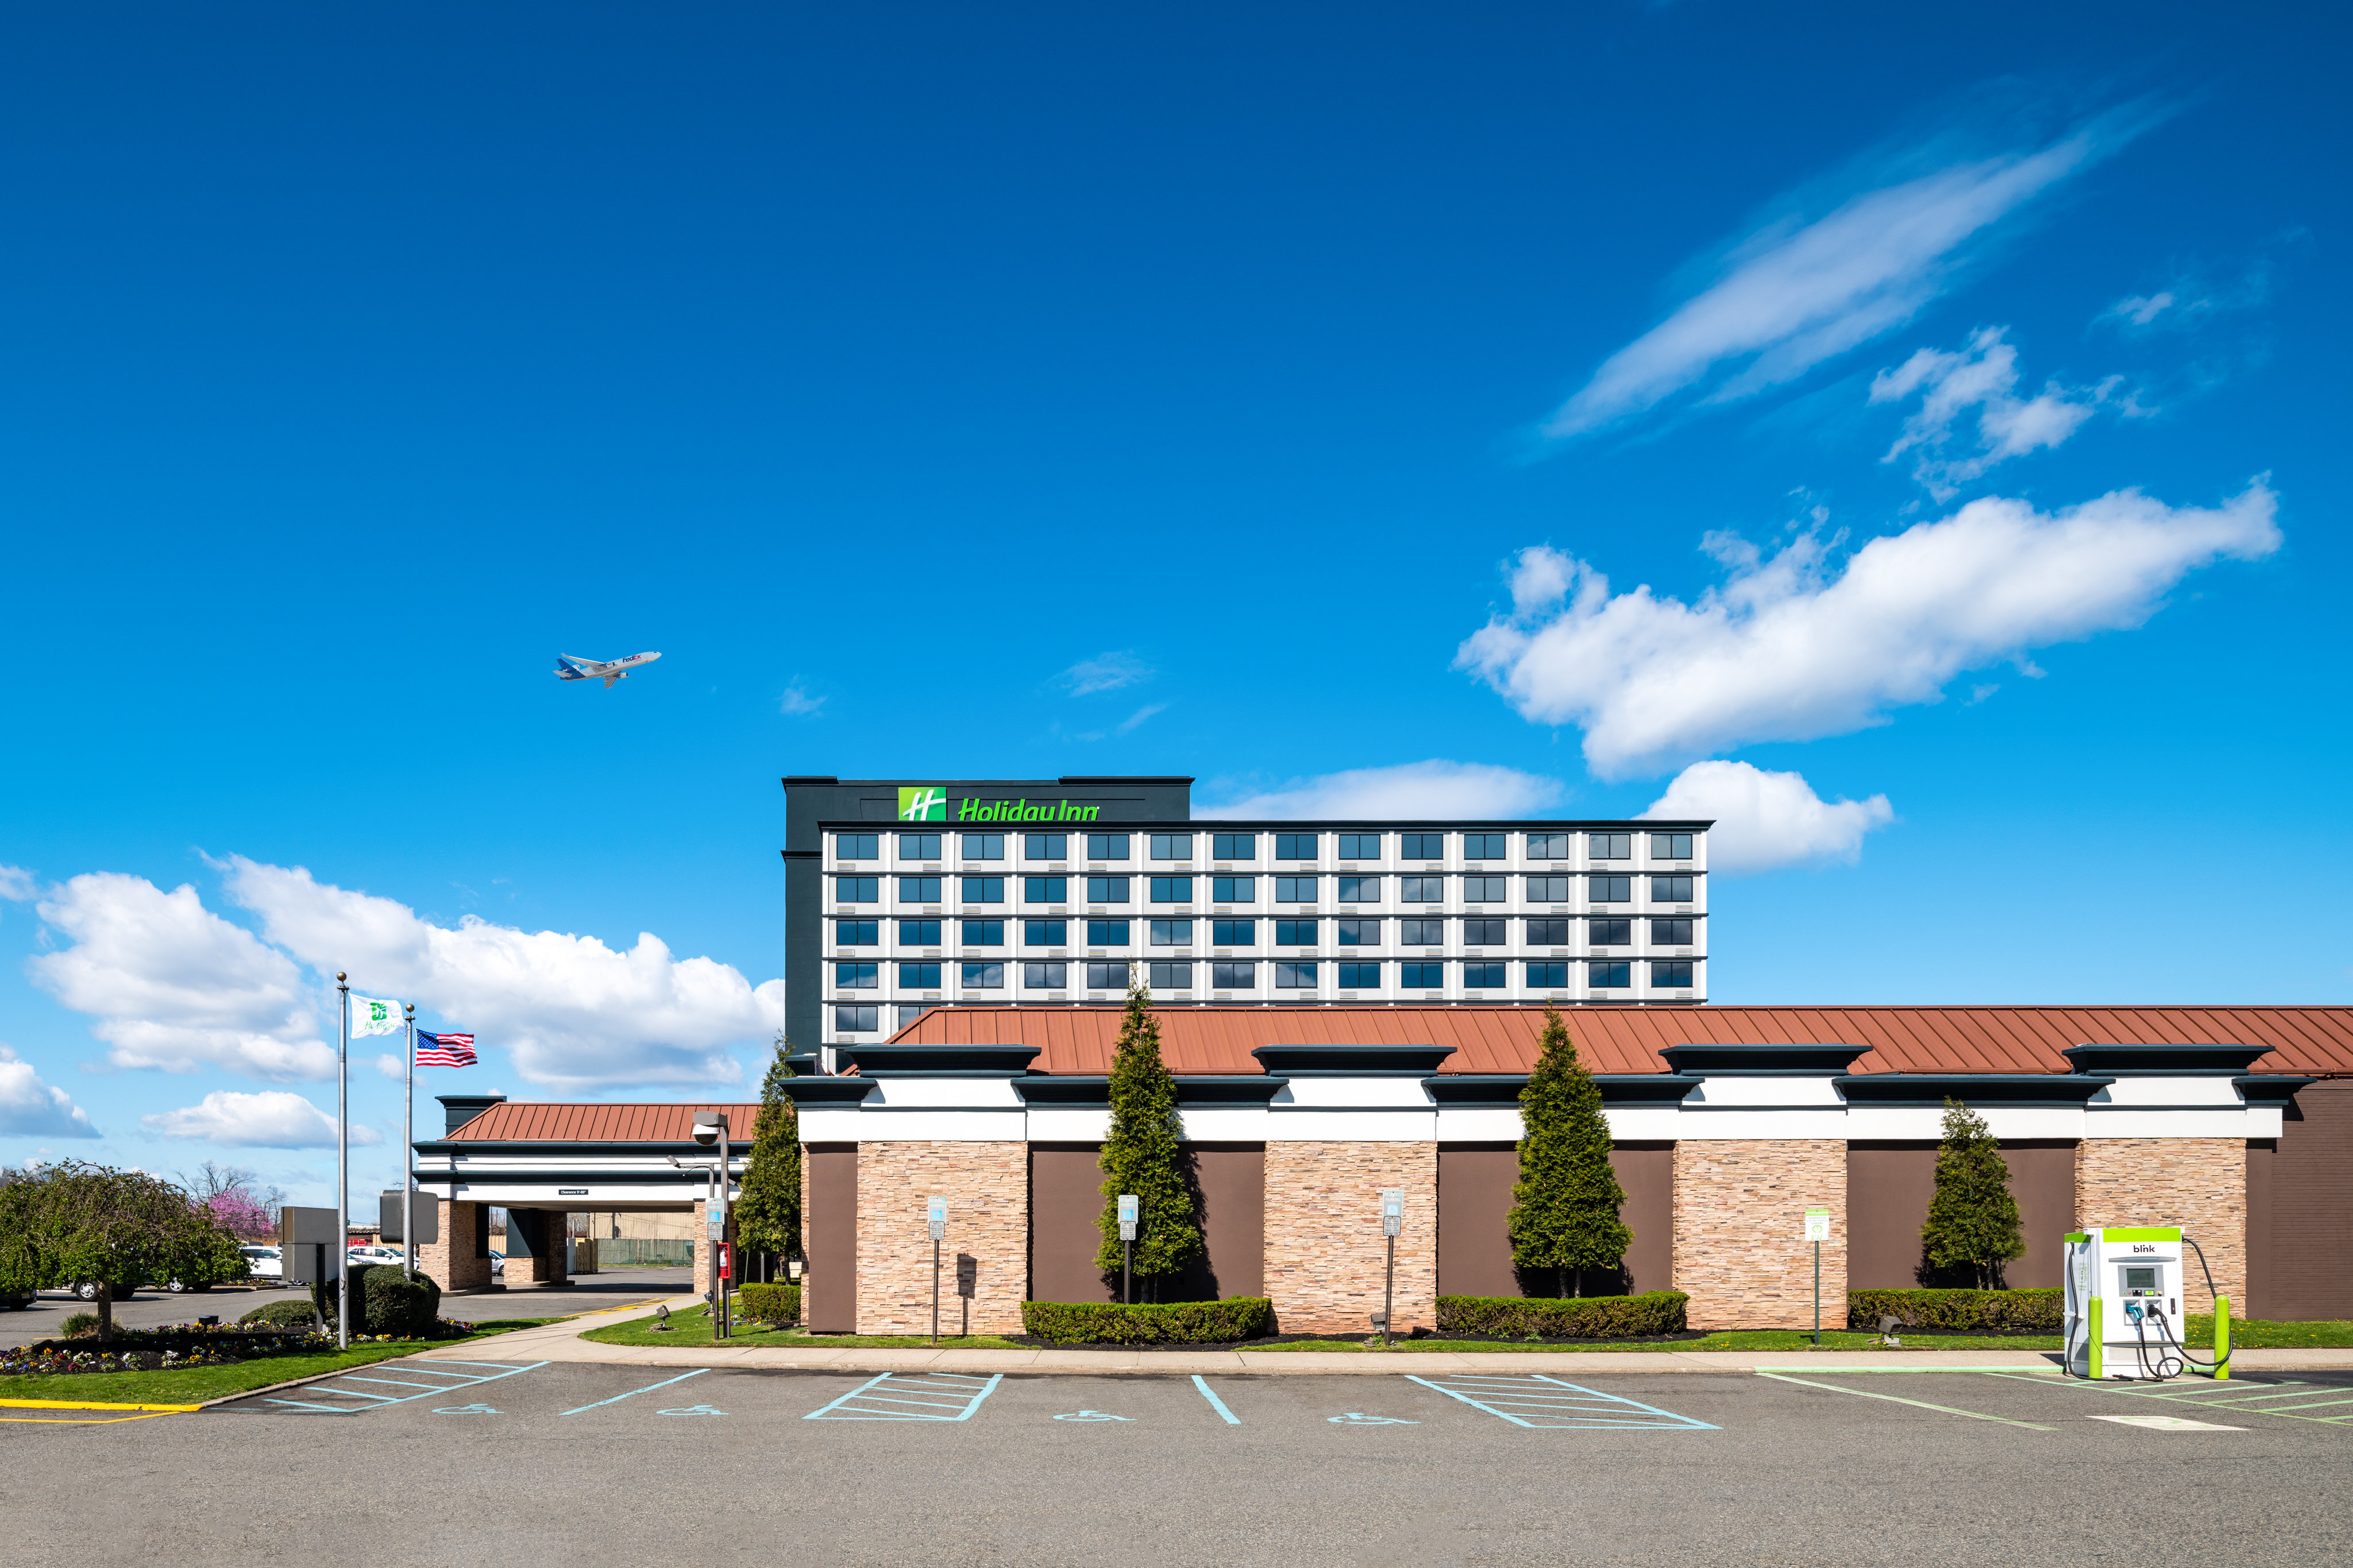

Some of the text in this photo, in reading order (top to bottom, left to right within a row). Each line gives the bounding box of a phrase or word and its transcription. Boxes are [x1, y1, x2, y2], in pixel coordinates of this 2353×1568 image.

[622, 654, 642, 663] FedEx
[958, 798, 1098, 821] Holiday Inn
[2133, 1244, 2155, 1253] blink
